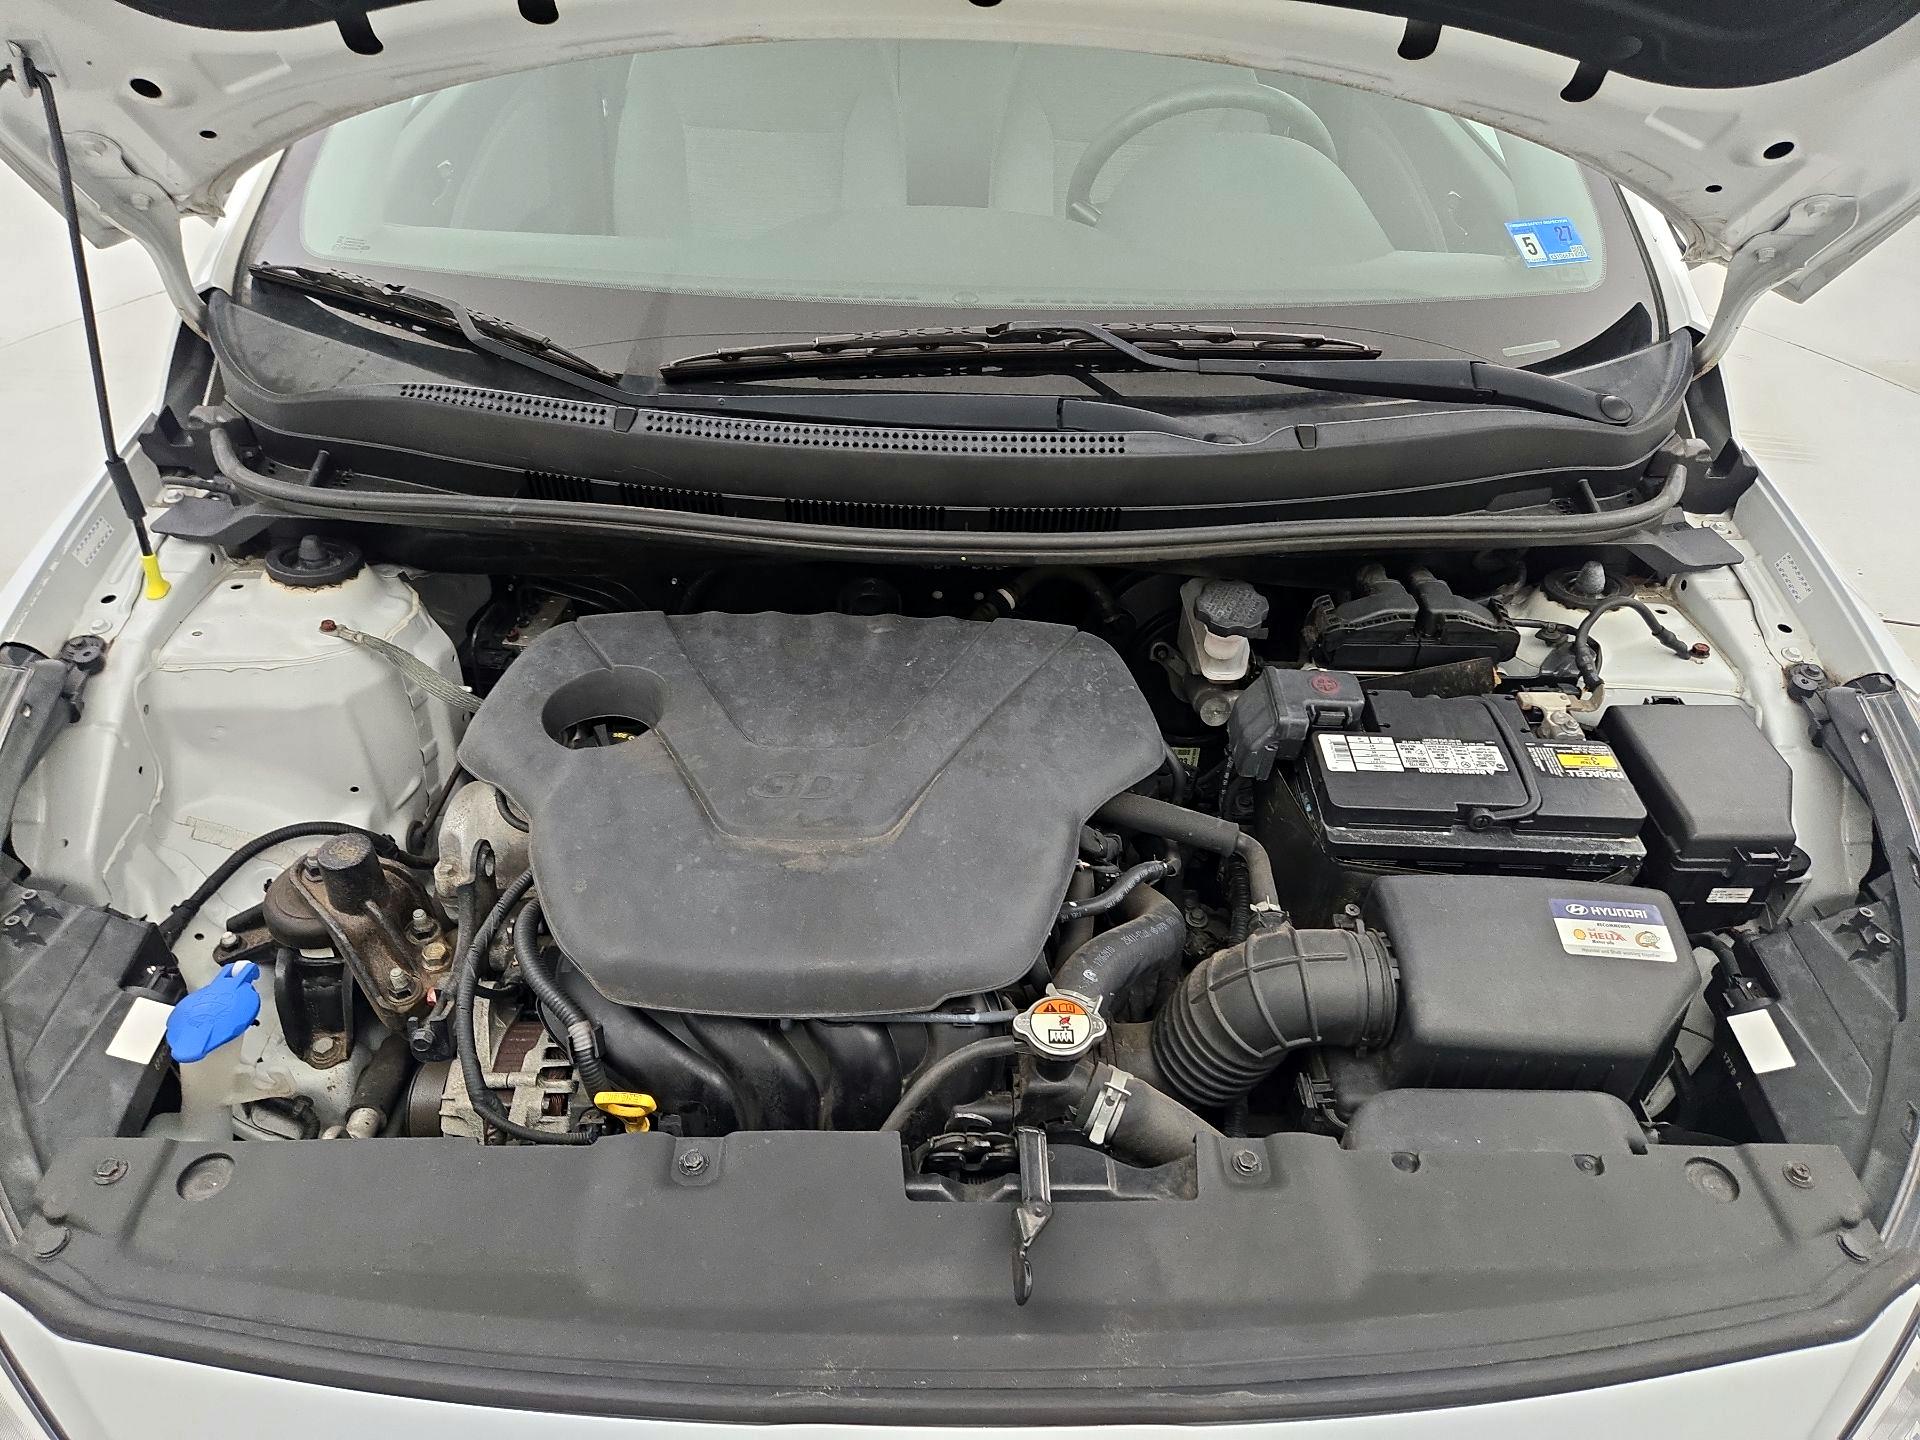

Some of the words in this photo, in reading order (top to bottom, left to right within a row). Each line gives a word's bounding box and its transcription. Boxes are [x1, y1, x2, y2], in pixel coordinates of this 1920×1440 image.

[1554, 226, 1573, 241] 27
[1522, 236, 1538, 256] 5
[1567, 769, 1625, 779] DURACELL
[1590, 907, 1648, 919] HYUNDAI
[1589, 931, 1627, 942] HELIX
